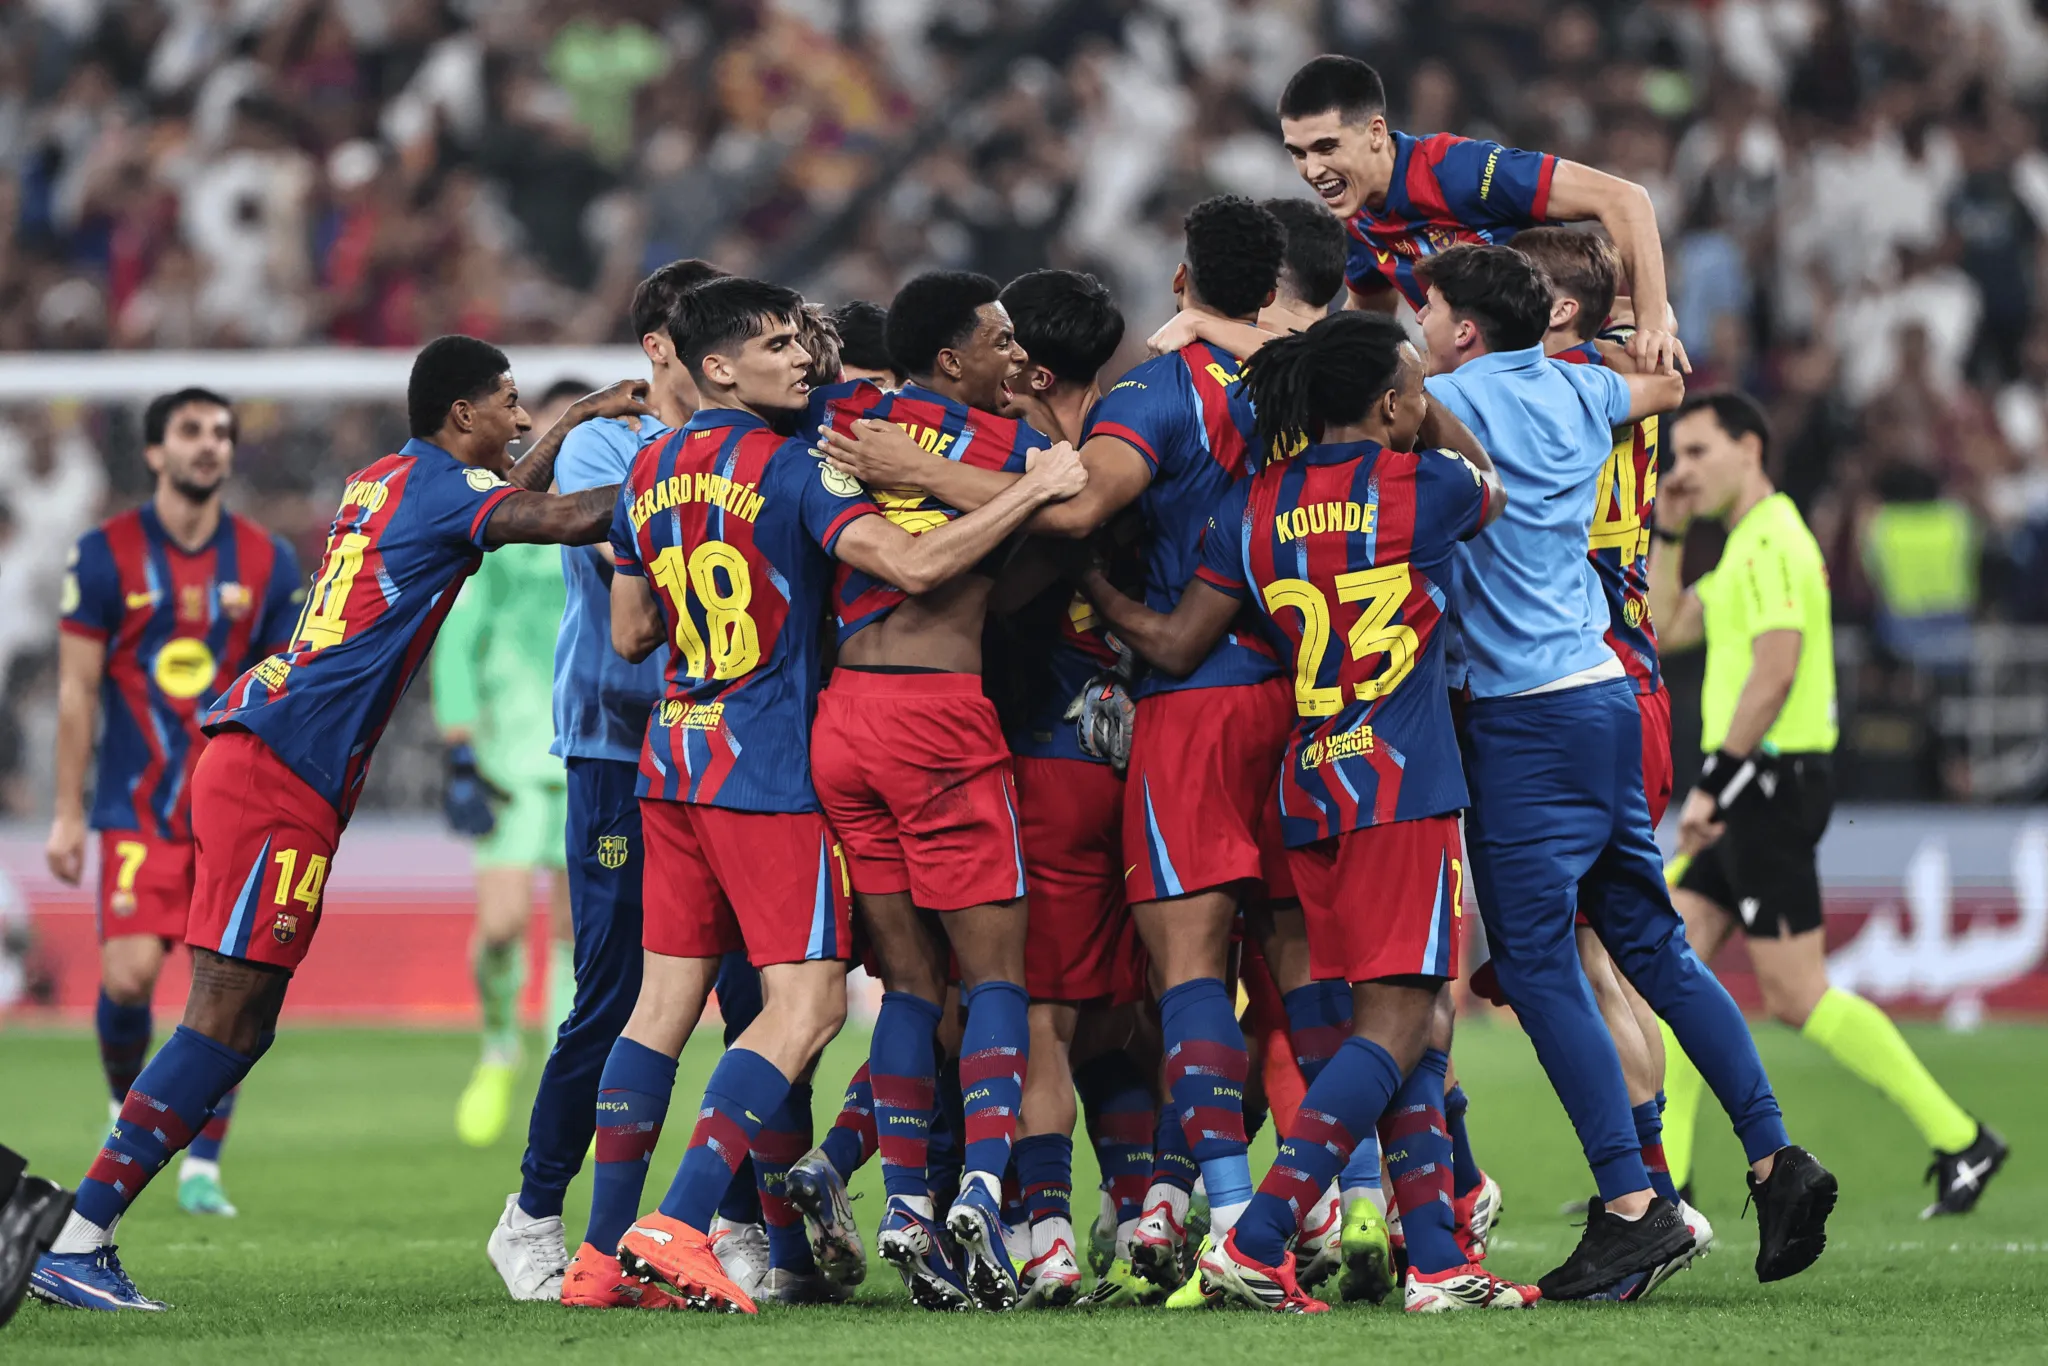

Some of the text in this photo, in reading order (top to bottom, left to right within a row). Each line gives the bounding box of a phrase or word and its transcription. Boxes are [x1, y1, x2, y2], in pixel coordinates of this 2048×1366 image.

[629, 472, 766, 533] GERARD MARTÍN
[1275, 501, 1378, 544] KOUNDE
[649, 540, 761, 680] 18
[1262, 562, 1420, 717] 23
[680, 713, 721, 726] ACNUR
[1325, 737, 1374, 759] ACNUR
[115, 840, 147, 890] 7
[274, 848, 328, 912] 14
[889, 1116, 928, 1128] BARÇA
[1163, 1152, 1196, 1171] BARÇA
